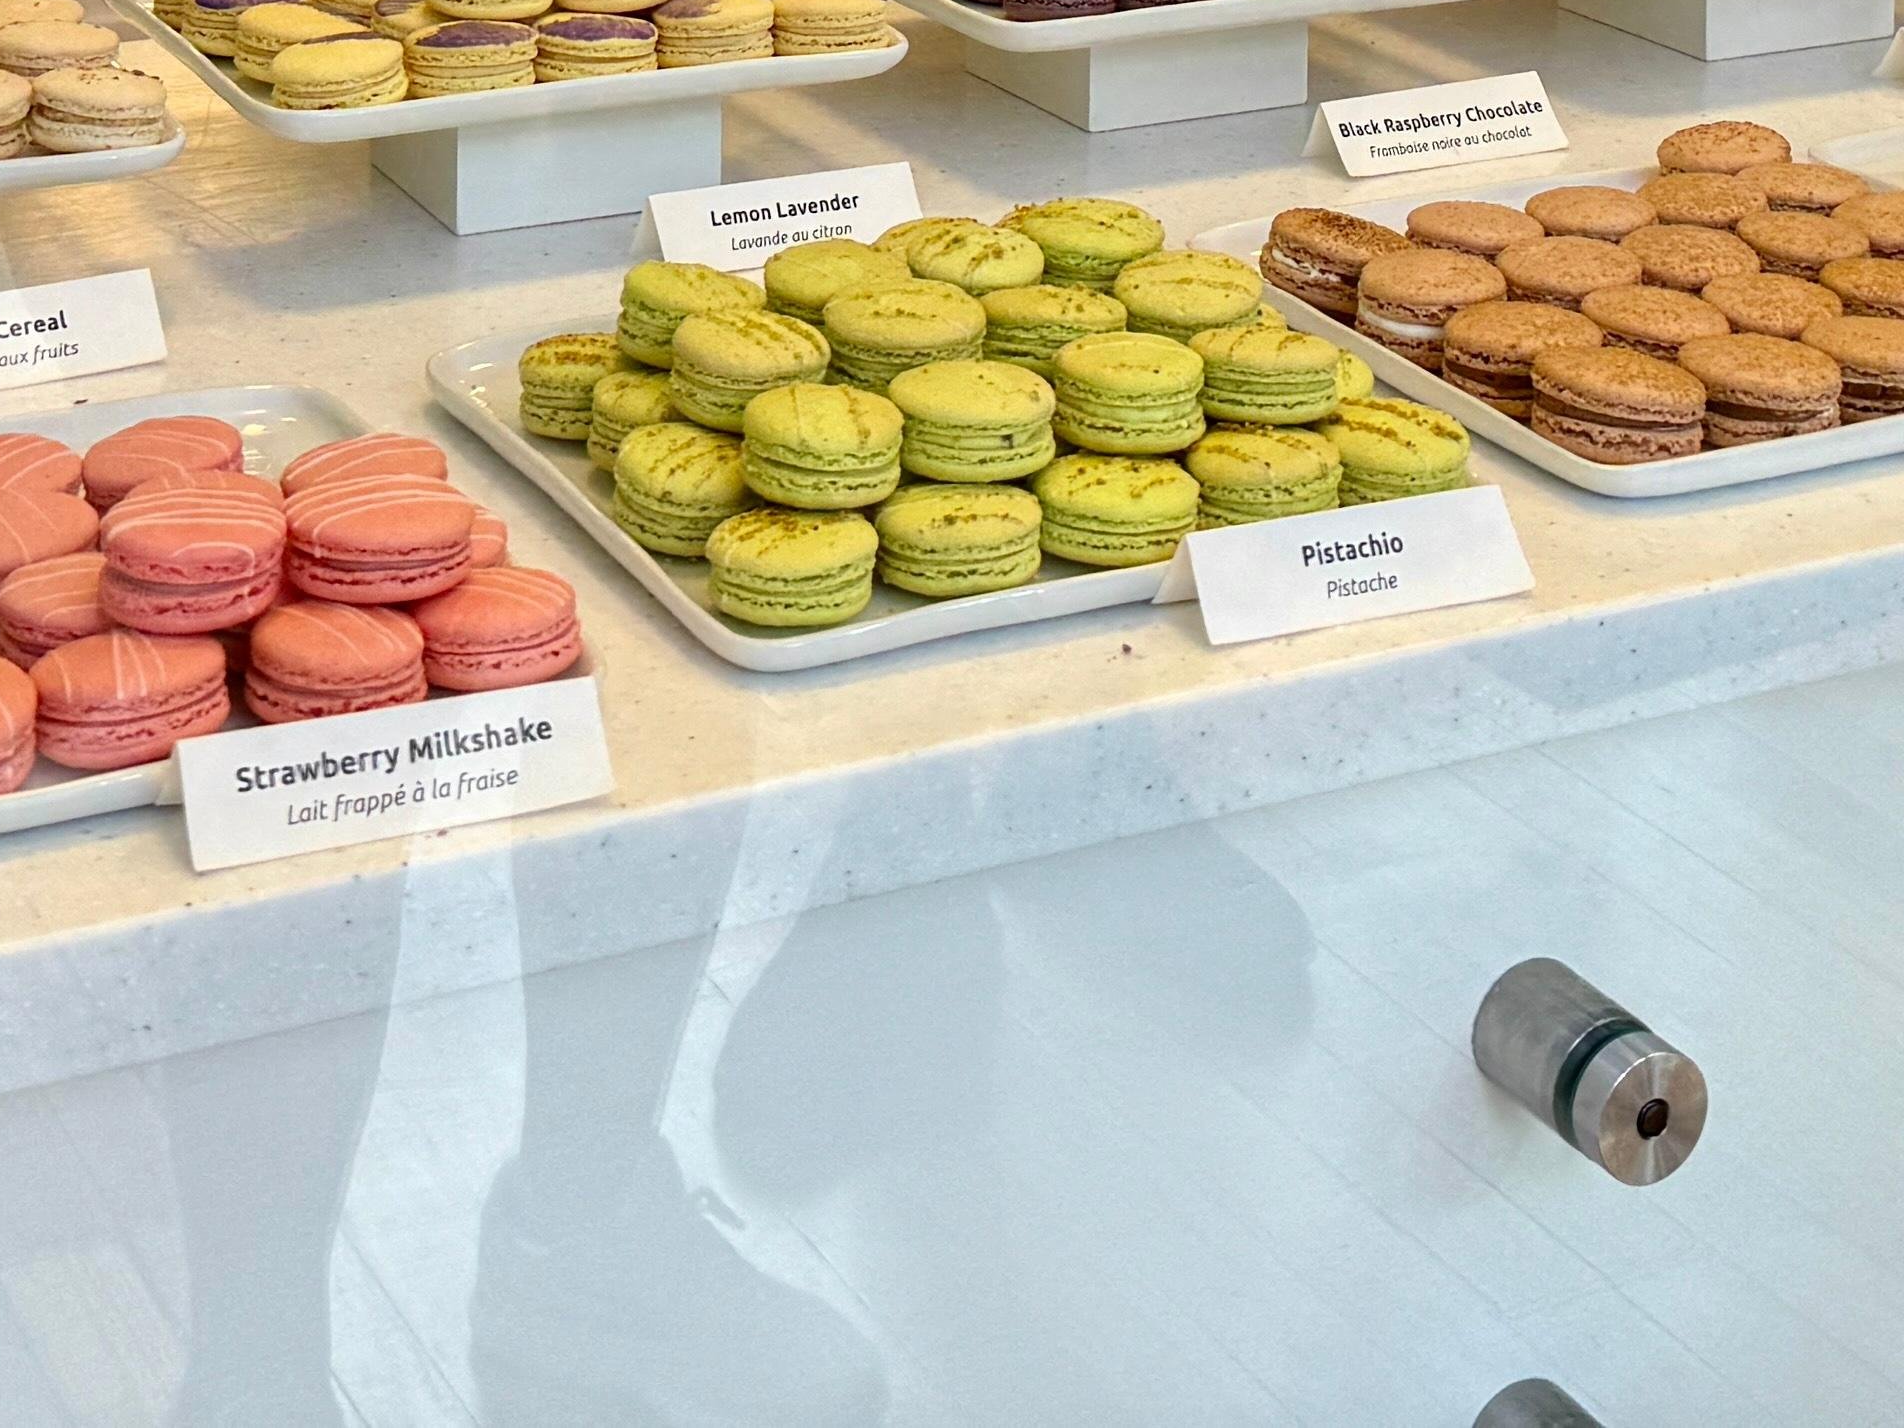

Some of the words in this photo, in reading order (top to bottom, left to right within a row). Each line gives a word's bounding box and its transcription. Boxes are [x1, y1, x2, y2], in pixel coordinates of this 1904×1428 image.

[1339, 119, 1382, 138] Black
[1384, 111, 1462, 133] Raspberry
[1466, 100, 1543, 122] Chocolate
[1370, 137, 1429, 159] Framboise
[1432, 136, 1461, 151] noire
[1464, 135, 1478, 146] au
[1482, 125, 1532, 143] chocolat
[711, 205, 771, 227] Lemon
[776, 193, 859, 219] Lavender
[731, 230, 788, 251] Lavande
[792, 229, 809, 242] au
[813, 223, 852, 239] citron
[32, 342, 79, 365] fruits
[1302, 531, 1404, 567] Pistachio
[1326, 571, 1398, 599] Pistache
[236, 745, 400, 793] Strawberry
[409, 716, 553, 764] Milkshake
[287, 801, 328, 826] Lait
[334, 783, 407, 822] frappé
[412, 780, 426, 801] à
[432, 777, 452, 799] la
[457, 767, 519, 796] fraise
